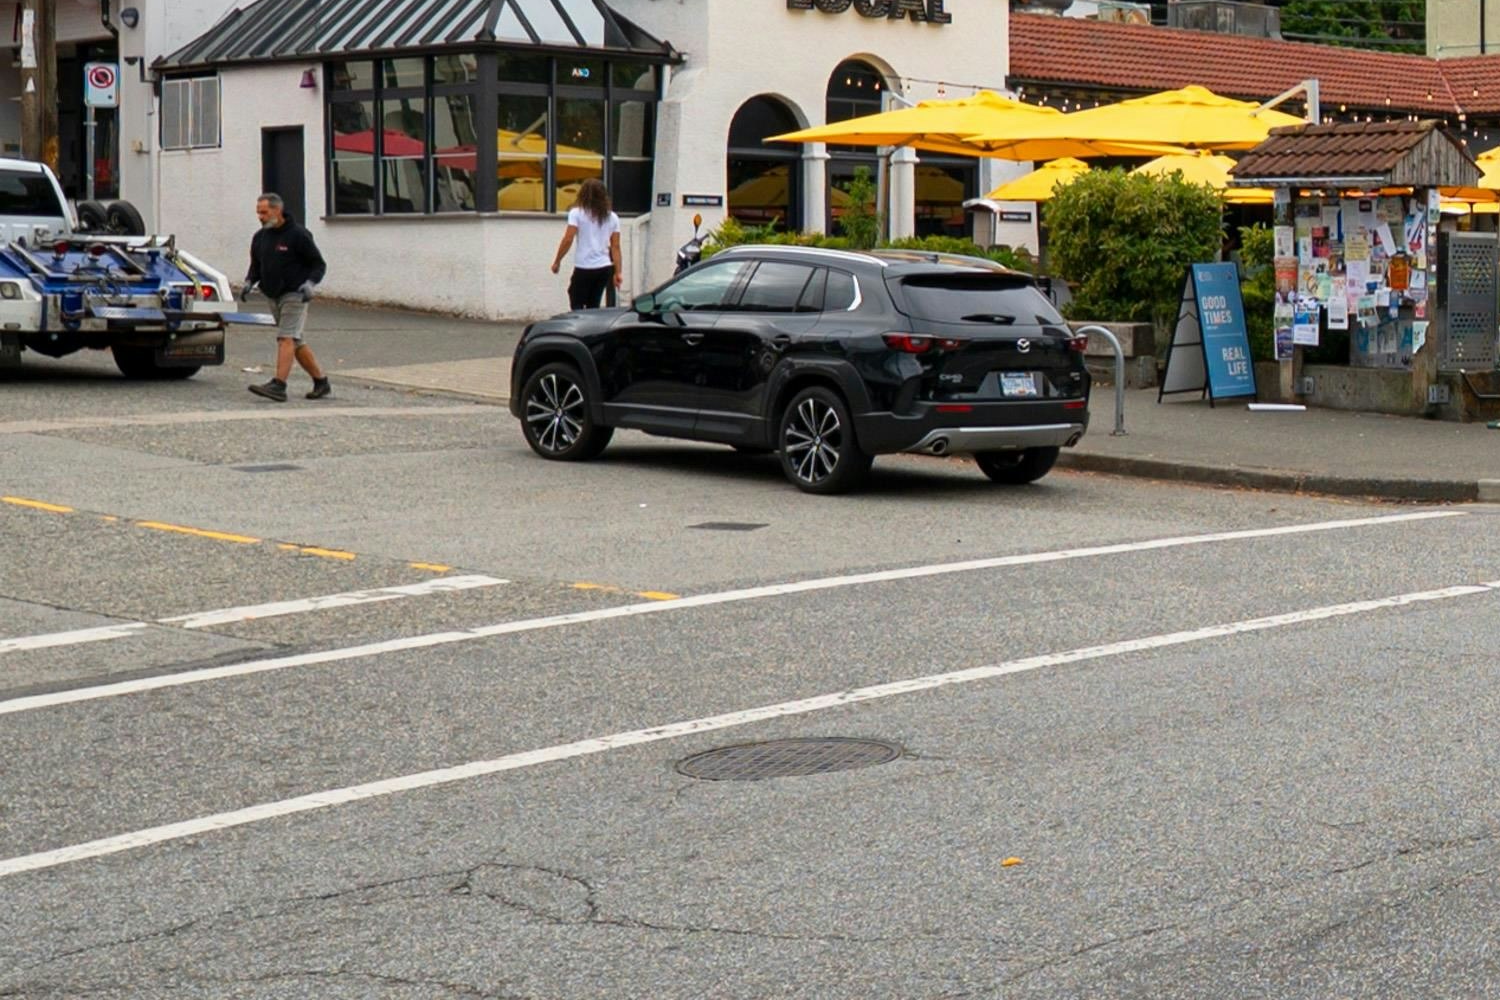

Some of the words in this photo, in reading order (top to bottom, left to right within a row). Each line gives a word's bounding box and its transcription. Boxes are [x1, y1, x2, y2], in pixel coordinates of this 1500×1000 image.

[1201, 295, 1227, 310] GOOD
[1203, 310, 1232, 325] TIMES
[1221, 346, 1247, 361] REAL
[1227, 360, 1249, 376] LIFE
